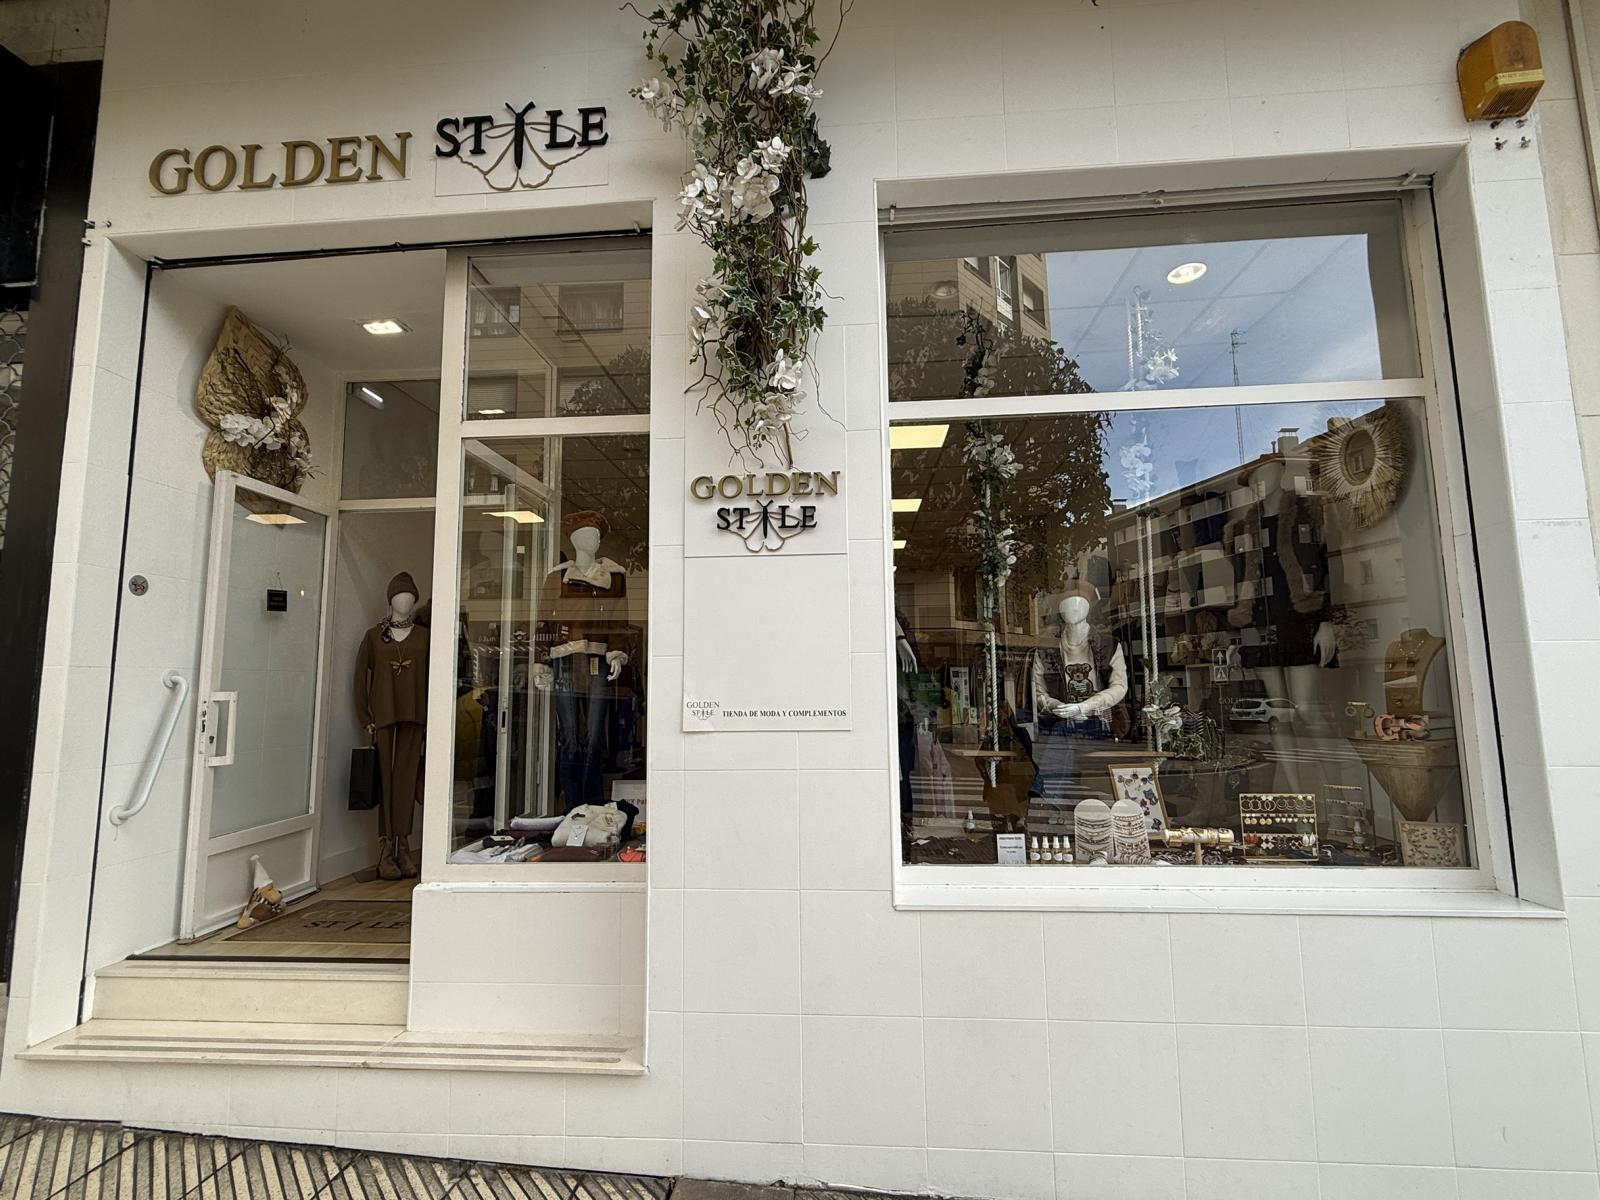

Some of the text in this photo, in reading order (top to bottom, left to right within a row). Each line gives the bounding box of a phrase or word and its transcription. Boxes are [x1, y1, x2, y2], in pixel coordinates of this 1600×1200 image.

[149, 102, 608, 195] GOLDEN STYLE
[690, 470, 841, 539] GOLDEN STYLE
[789, 710, 847, 718] COMPLEMENTOS
